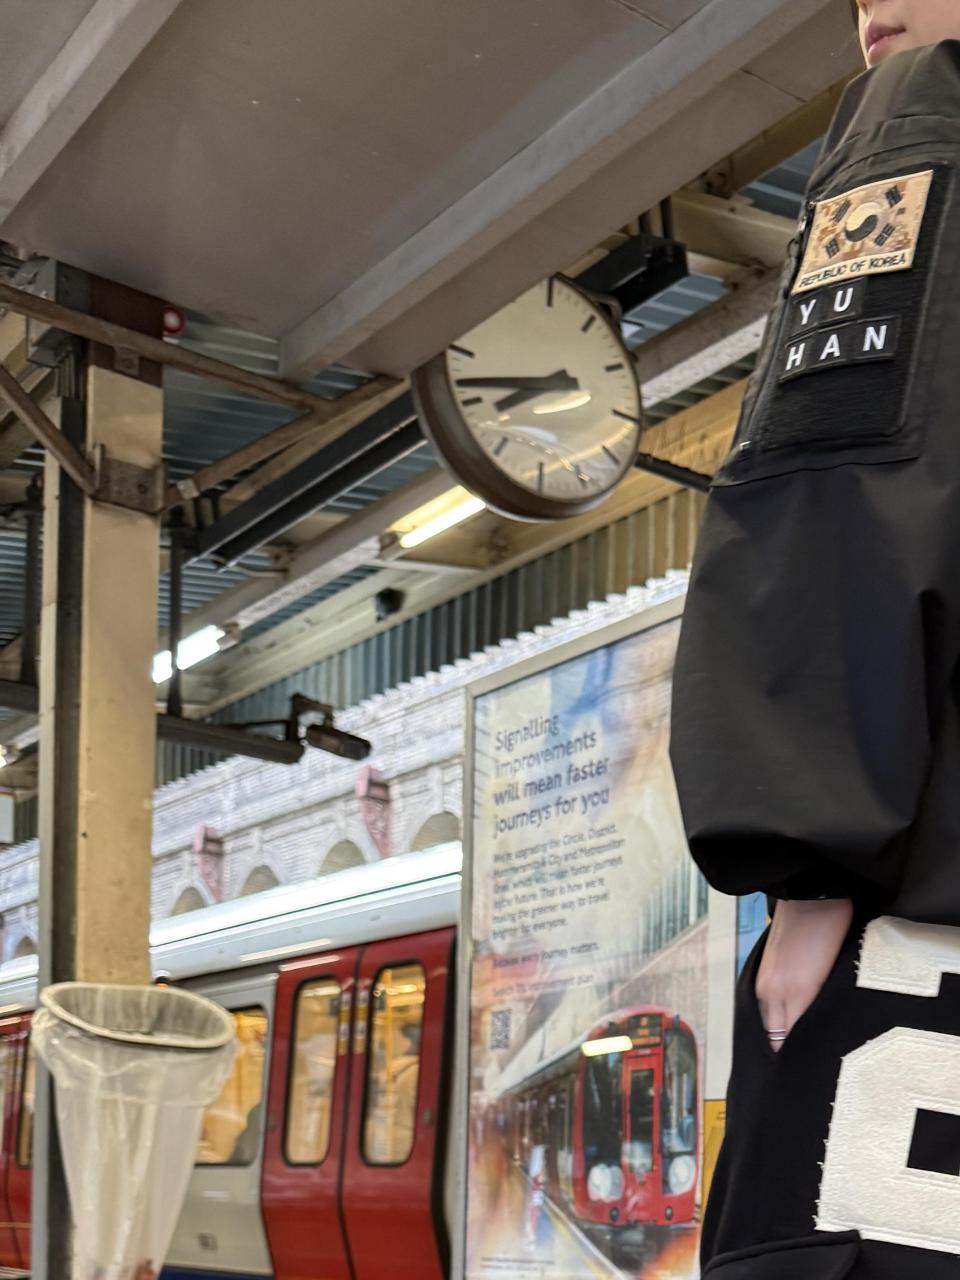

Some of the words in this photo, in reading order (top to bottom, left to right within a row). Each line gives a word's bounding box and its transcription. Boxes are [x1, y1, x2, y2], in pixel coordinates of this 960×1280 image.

[799, 264, 847, 287] REPUBLIC
[850, 260, 865, 272] OF
[868, 254, 905, 269] KOREA
[785, 325, 887, 370] HAN
[495, 731, 597, 777] improvements
[496, 714, 560, 752] Signalling
[493, 782, 519, 806] will
[523, 773, 562, 797] mean
[566, 757, 609, 785] faster
[493, 805, 552, 839] journeys
[555, 796, 578, 816] for
[581, 788, 609, 815] you
